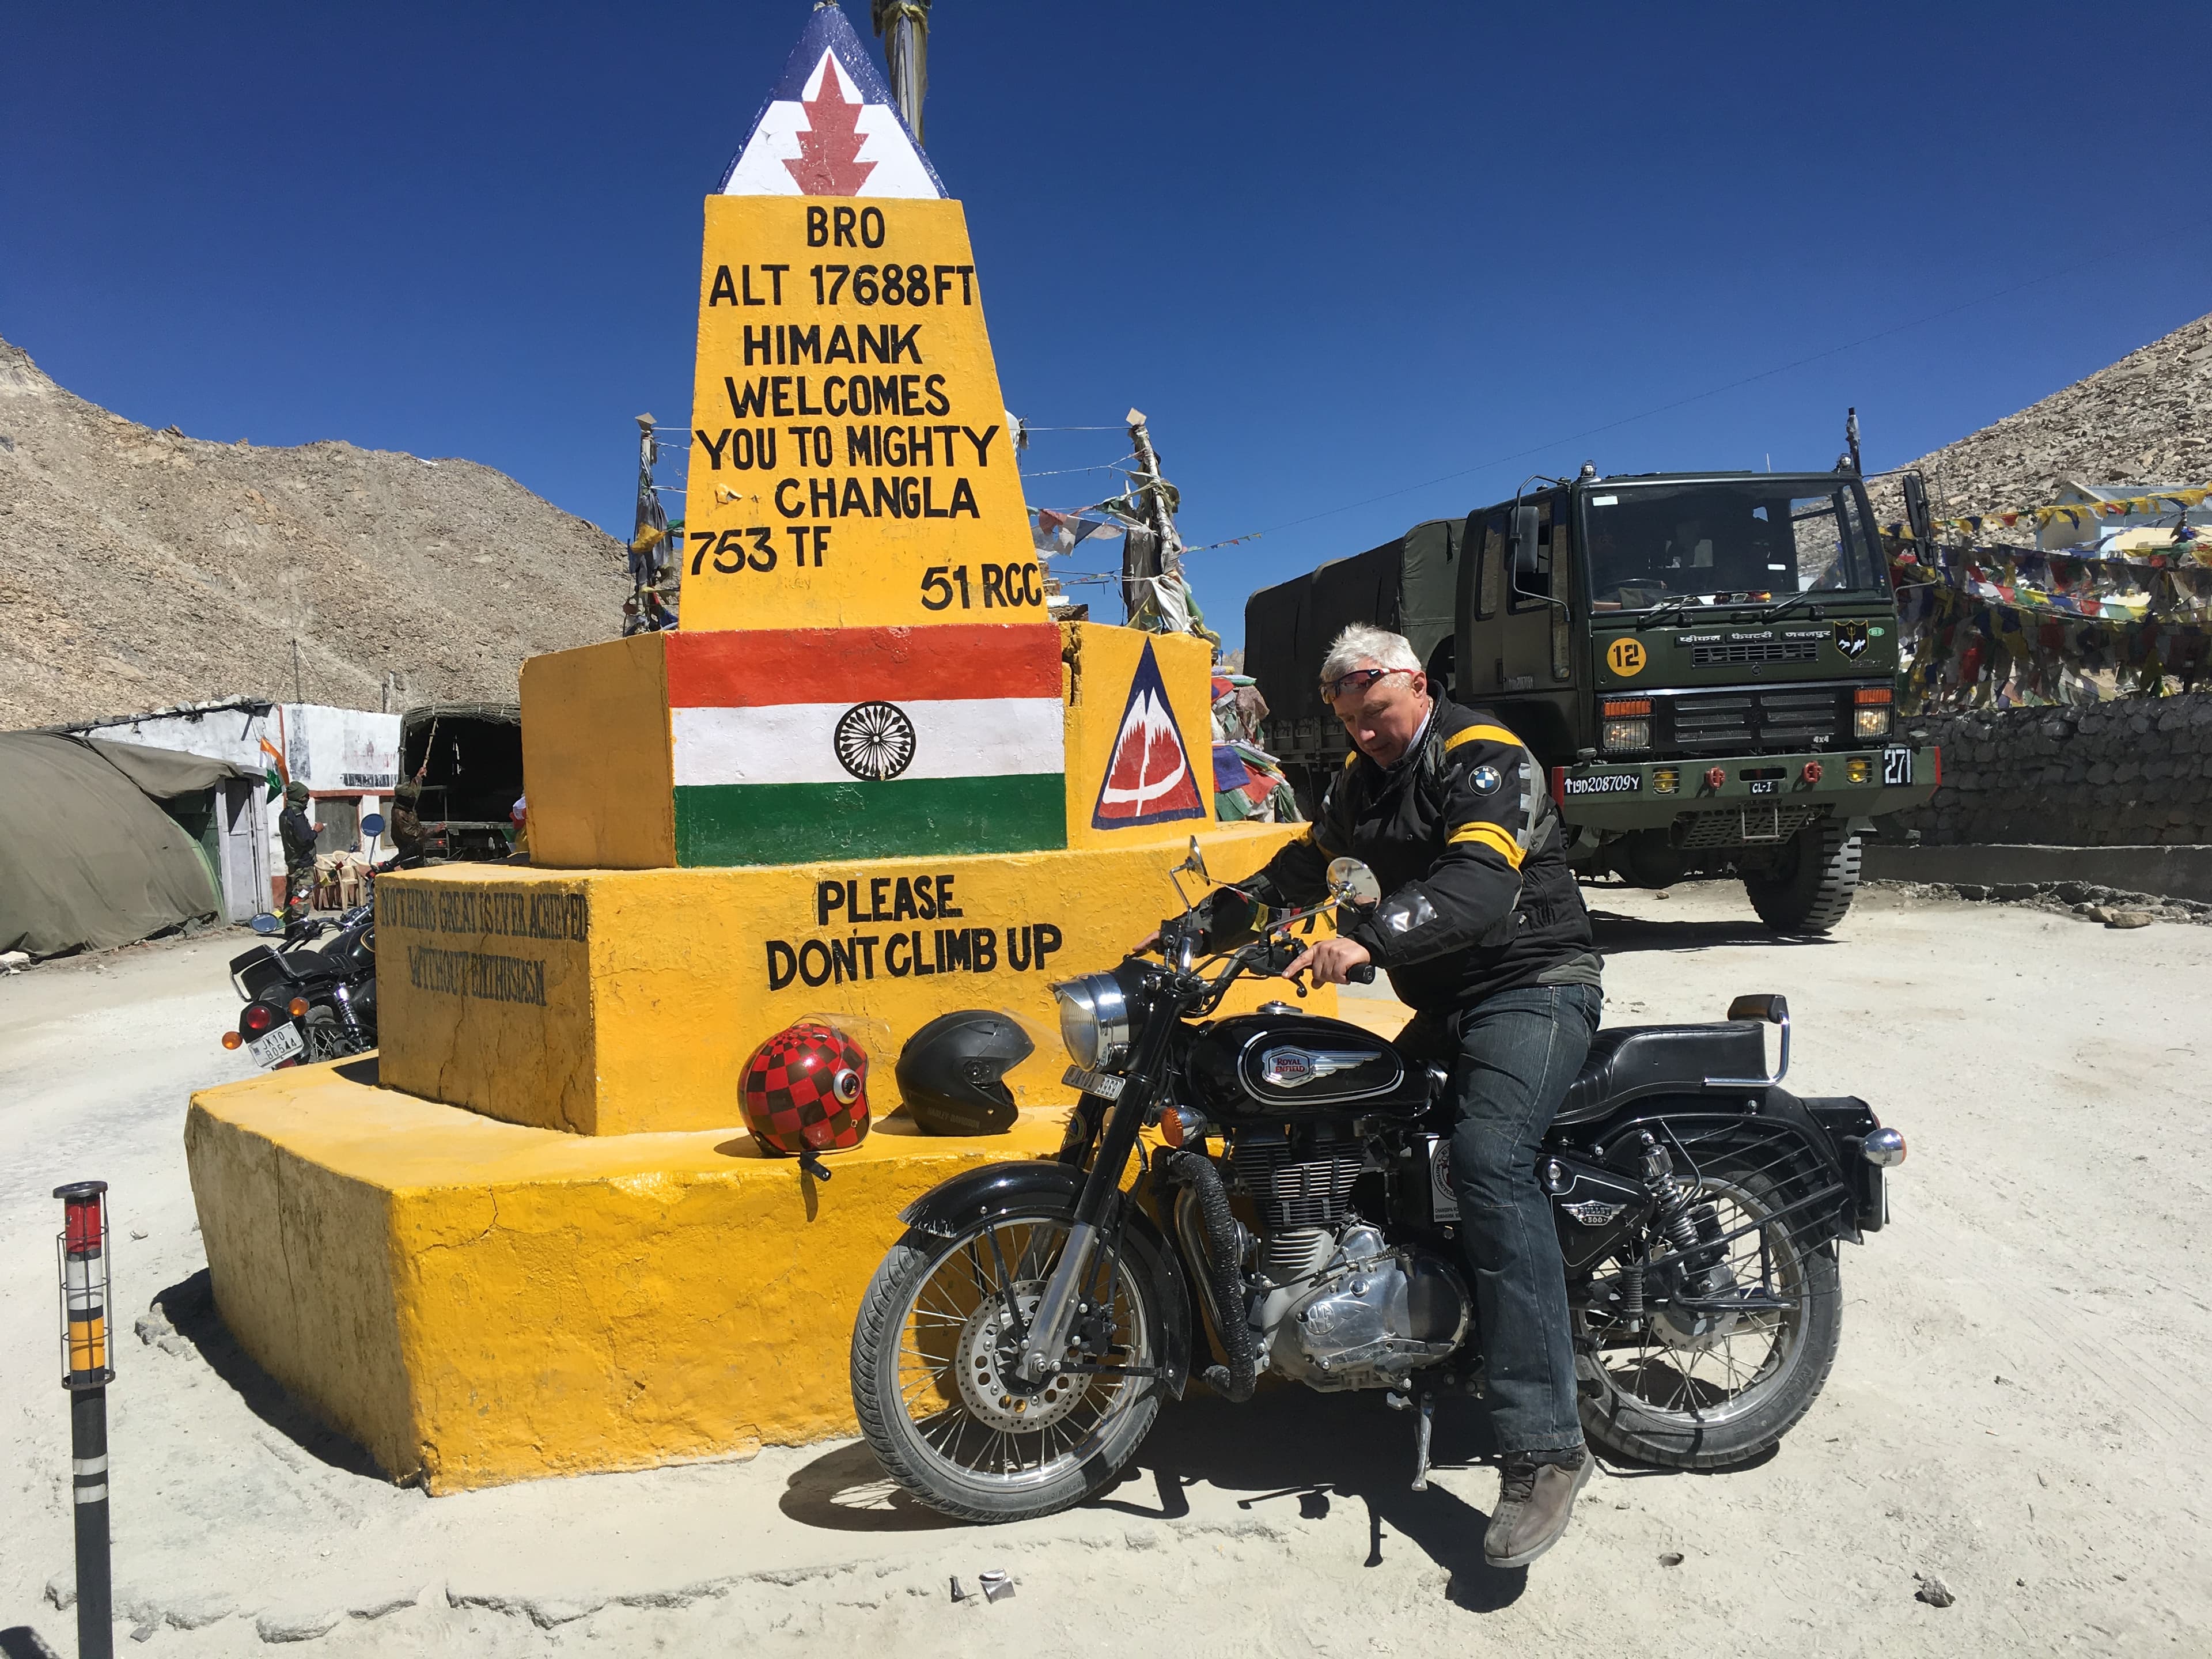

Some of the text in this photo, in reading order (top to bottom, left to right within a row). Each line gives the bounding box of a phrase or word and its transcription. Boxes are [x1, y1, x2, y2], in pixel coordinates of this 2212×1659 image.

[808, 206, 885, 248] BRO
[709, 264, 789, 306] ALT
[744, 324, 923, 366] HIMANK
[724, 374, 950, 418] WELCOMES
[695, 425, 999, 470] YOU TO MIGHTY
[775, 476, 980, 519] CHANGLA
[690, 526, 831, 575] 753 TF
[921, 563, 1042, 611] 51 RCC
[1613, 644, 1639, 667] 12
[1474, 767, 1498, 777] BMW
[1884, 749, 1911, 784] 271
[381, 887, 589, 942] NOTHING GREAT IS EVER ACHIEVED
[818, 874, 963, 926] PLEASE
[407, 945, 547, 1006] WITHOUT ENTHUSIASM
[766, 923, 1062, 991] DON'T CLIMB UP
[262, 1031, 285, 1050] JK10
[1578, 1207, 1611, 1215] BULLET
